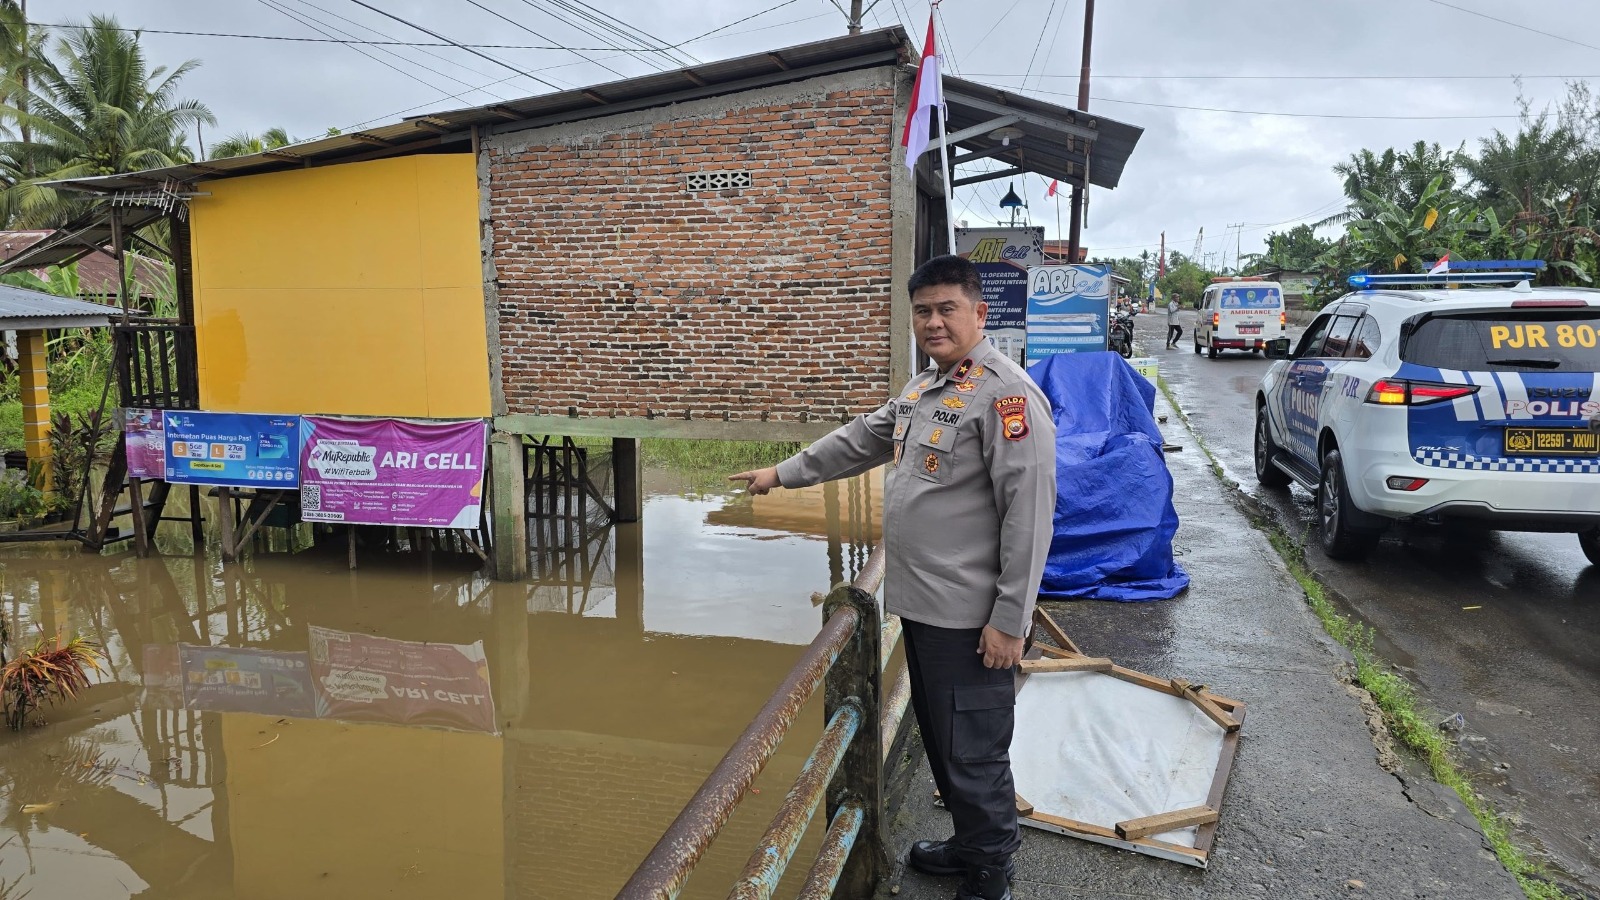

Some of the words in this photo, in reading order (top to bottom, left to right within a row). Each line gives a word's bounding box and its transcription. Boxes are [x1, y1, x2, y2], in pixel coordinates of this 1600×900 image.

[967, 238, 1008, 263] ARI
[1002, 245, 1031, 260] Cell
[1033, 269, 1078, 294] ARI
[1074, 280, 1104, 294] Cell
[1489, 324, 1550, 349] PJR
[1555, 324, 1600, 348] 80
[1341, 375, 1361, 399] PJR
[1526, 387, 1593, 399] ISUZU
[996, 397, 1025, 409] POLDA
[1291, 386, 1319, 421] POLISI
[1506, 400, 1600, 417] POLIS
[931, 409, 960, 425] POLRI
[167, 432, 200, 440] Internetan
[217, 434, 238, 442] Harga
[1536, 433, 1565, 448] 122591
[1572, 433, 1595, 448] XXVII
[215, 447, 220, 455] L
[321, 450, 371, 464] MyRepublic
[379, 451, 418, 469] ARI
[423, 453, 478, 470] CELL
[324, 468, 371, 476] #WifiTerbaik
